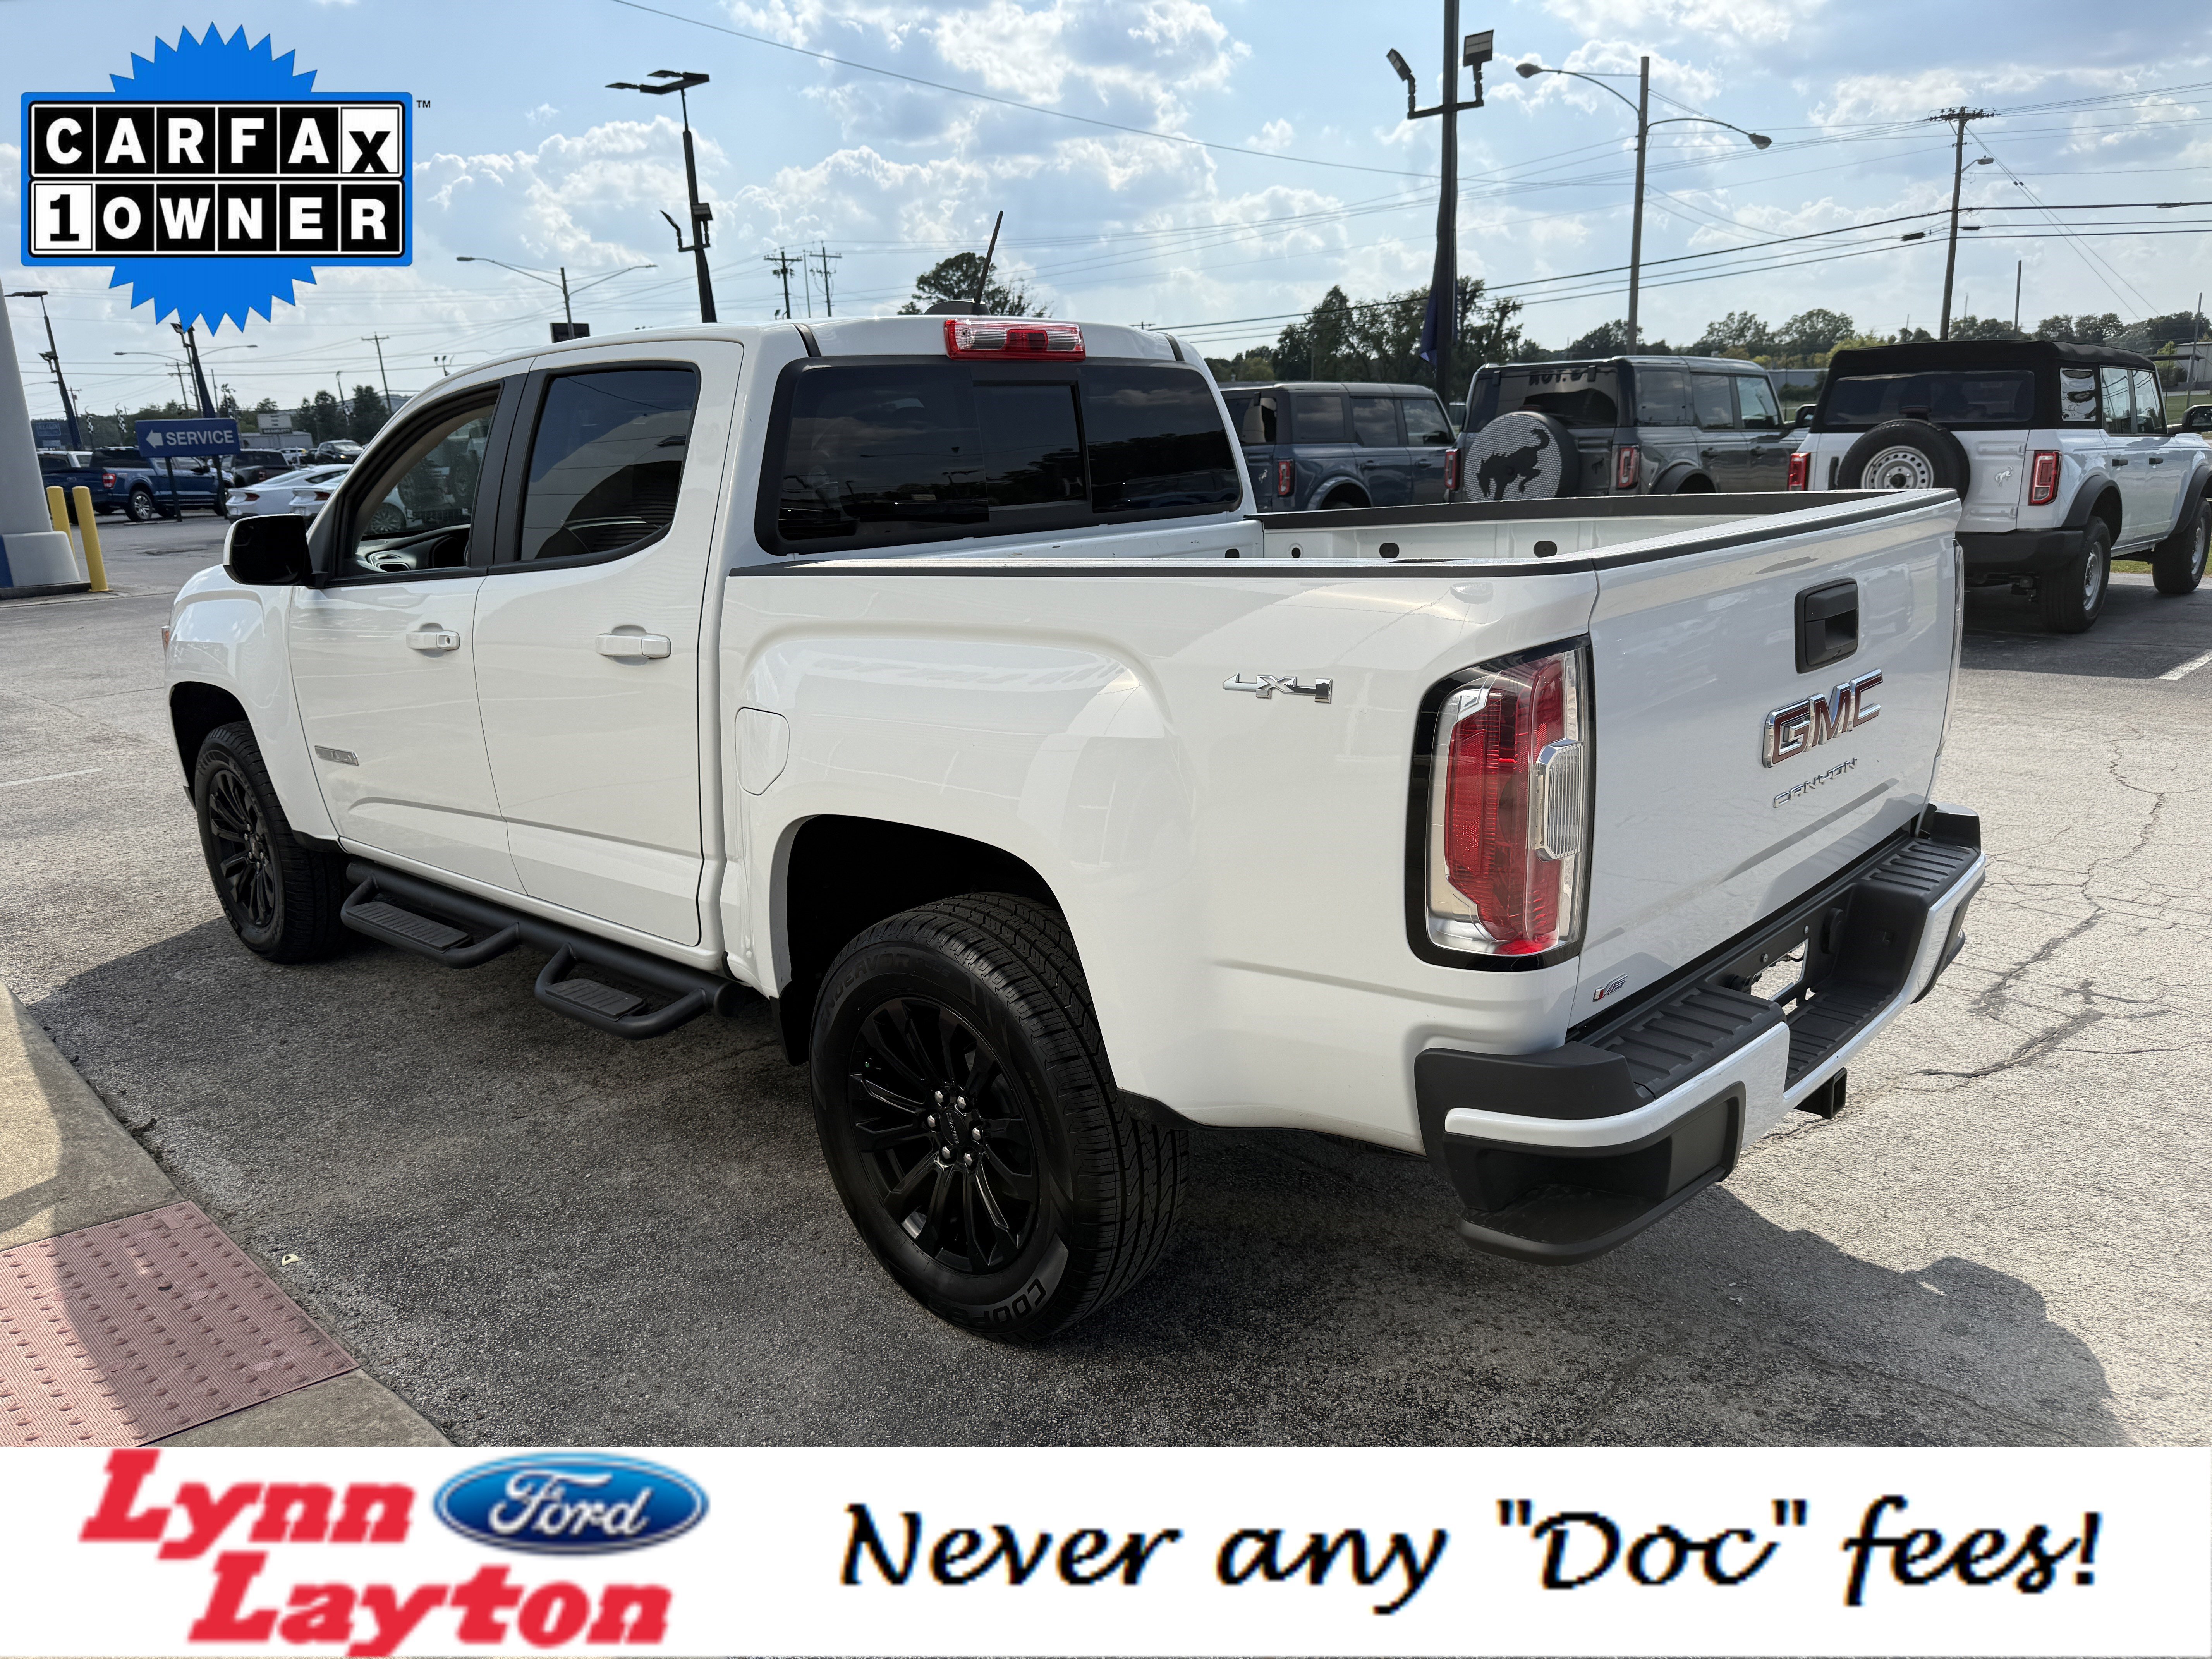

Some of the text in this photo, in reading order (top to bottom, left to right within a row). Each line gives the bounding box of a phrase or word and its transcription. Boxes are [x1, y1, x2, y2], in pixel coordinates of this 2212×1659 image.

[166, 430, 235, 445] SERVICE
[1763, 668, 1883, 768] GMC
[1773, 757, 1858, 808] CANYON
[819, 952, 911, 1031] ENDEAVOR
[945, 1112, 960, 1144] GMC
